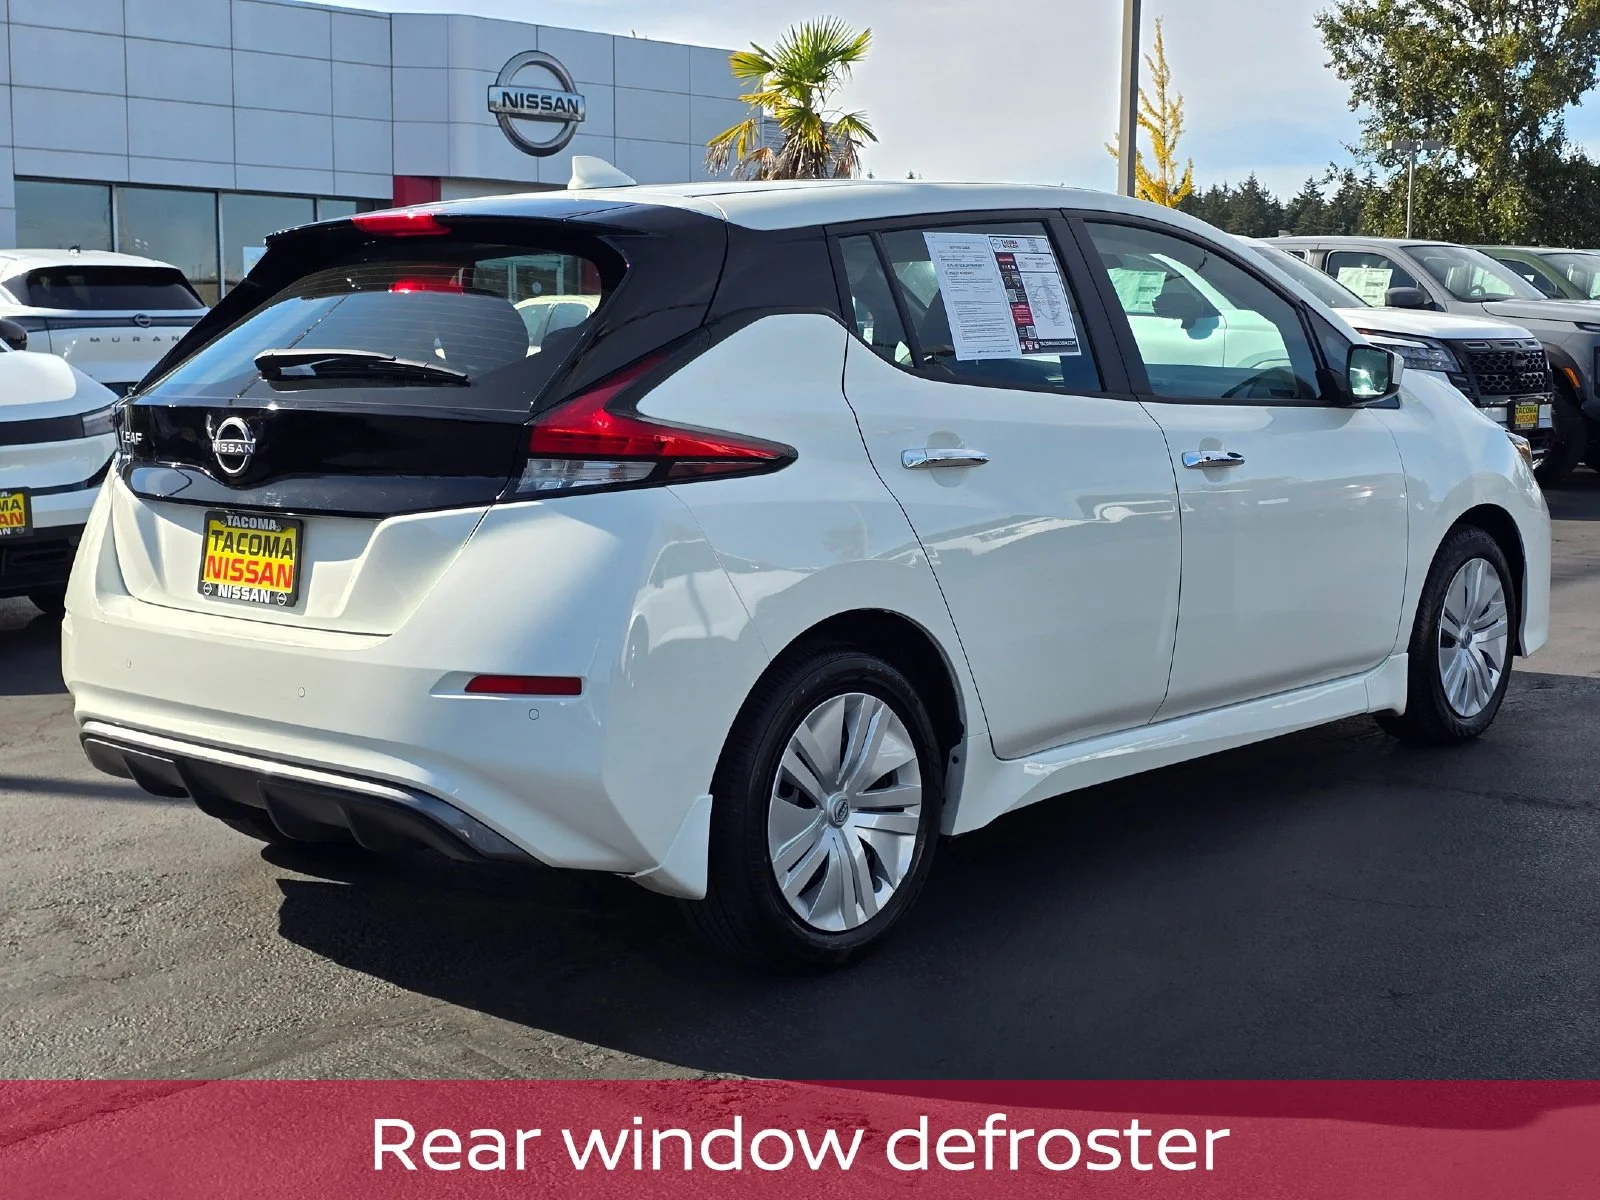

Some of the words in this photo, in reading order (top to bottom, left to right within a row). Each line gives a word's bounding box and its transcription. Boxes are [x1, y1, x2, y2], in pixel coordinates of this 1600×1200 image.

[502, 91, 579, 114] NISSAN
[1515, 406, 1537, 414] TACOMA
[1516, 414, 1537, 423] NISSAN
[213, 442, 254, 454] NISSAN
[226, 515, 277, 531] TACOMA
[212, 529, 293, 560] TACOMA
[206, 555, 294, 589] NISSAN
[217, 584, 271, 604] NISSAN
